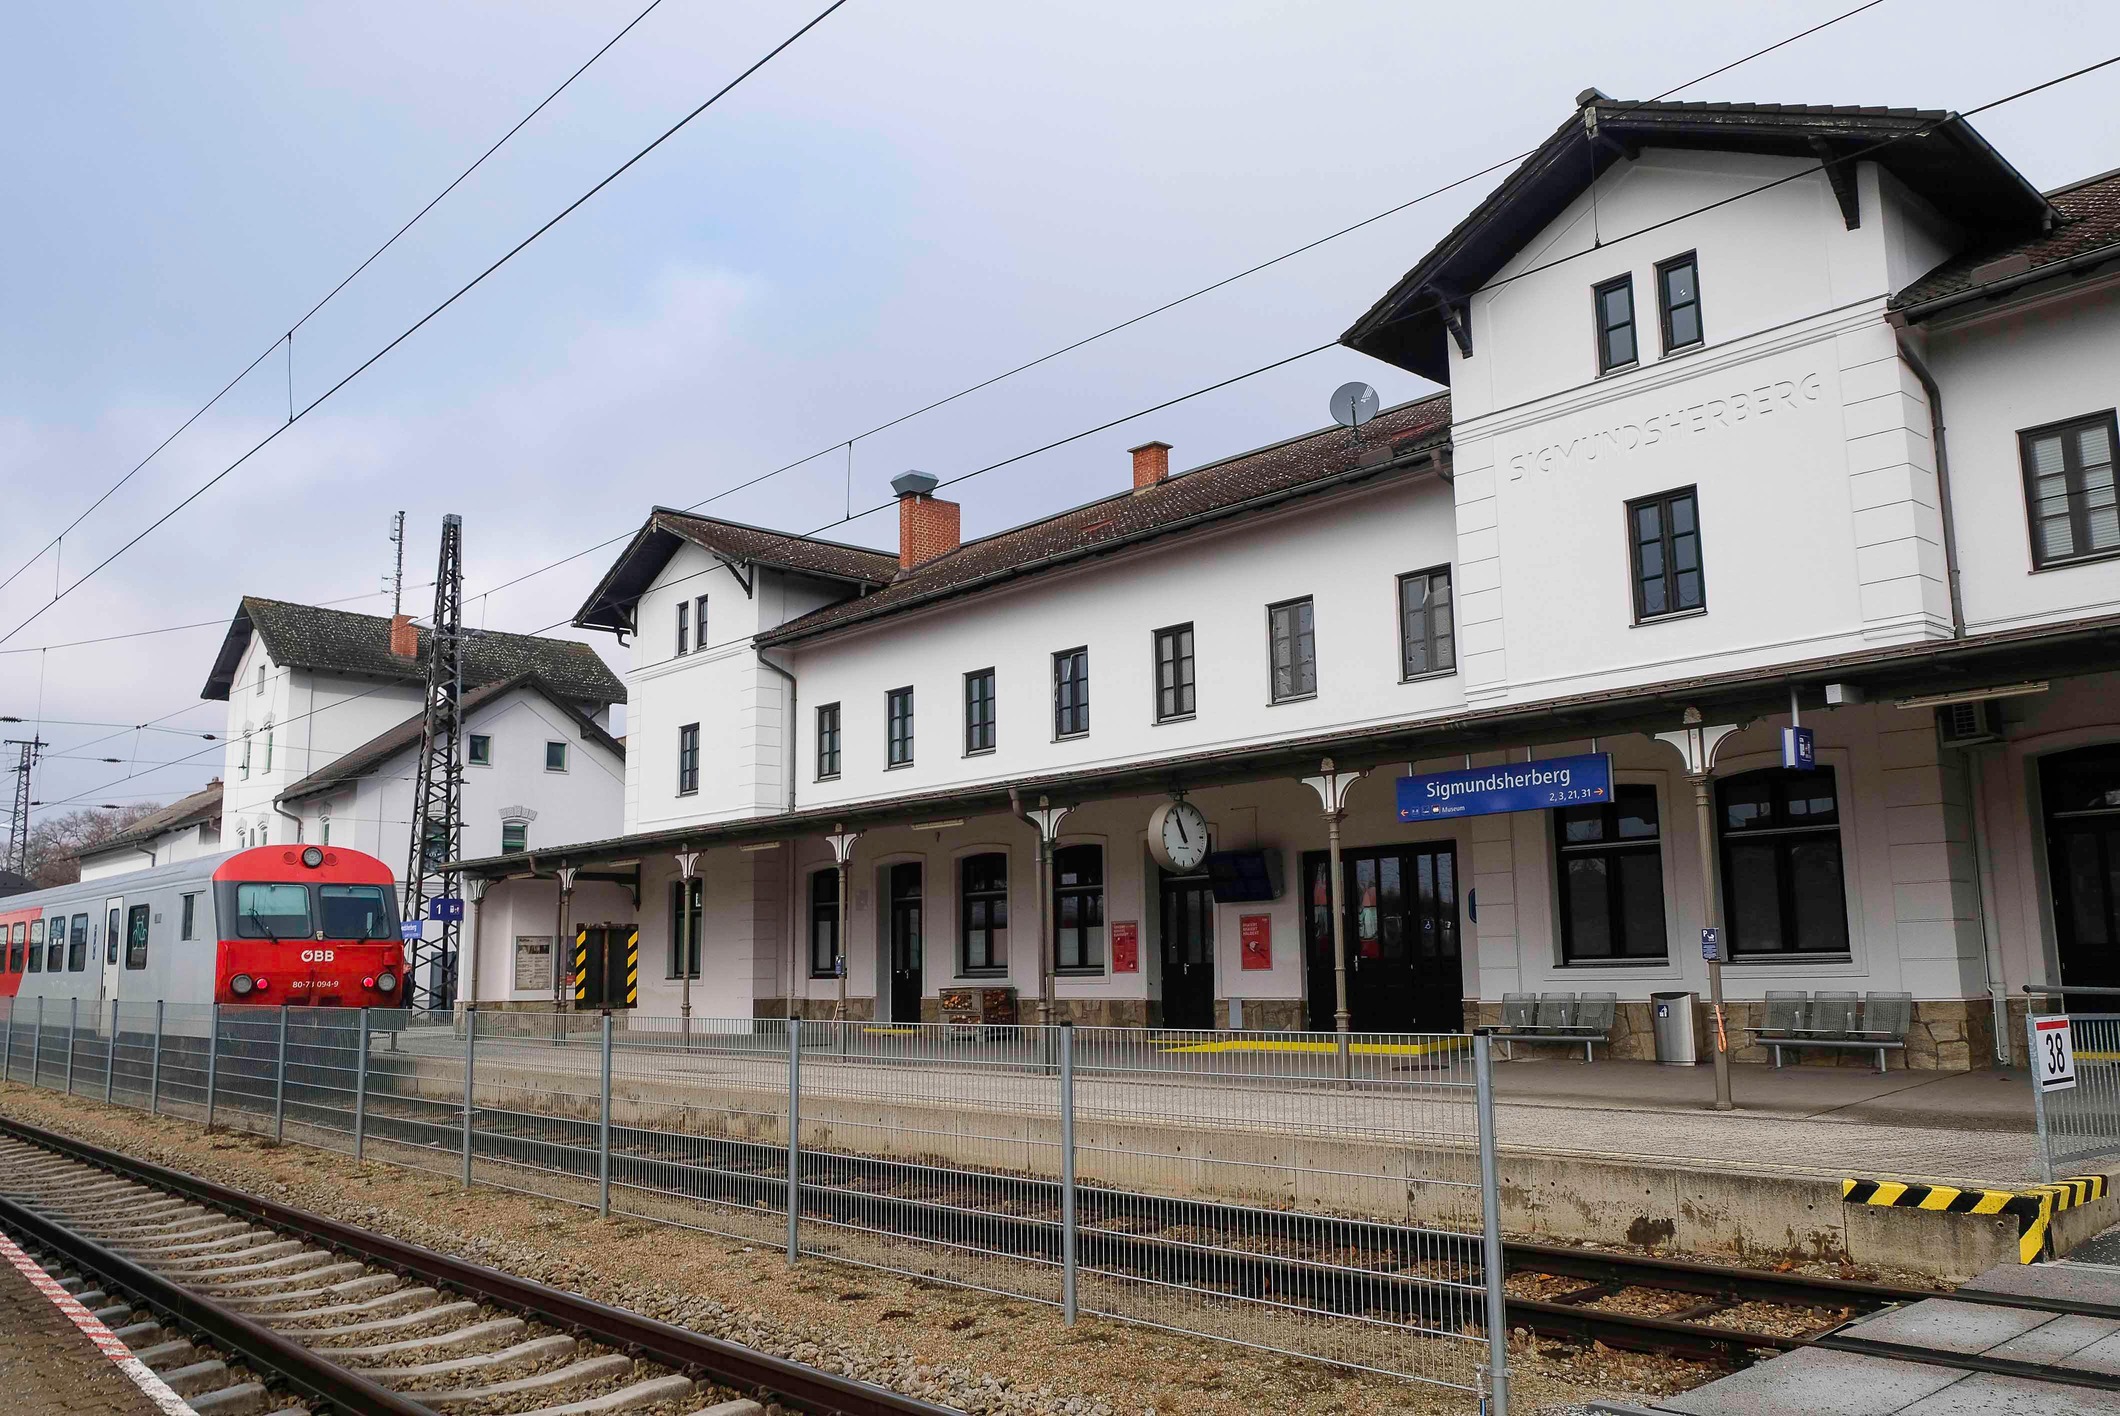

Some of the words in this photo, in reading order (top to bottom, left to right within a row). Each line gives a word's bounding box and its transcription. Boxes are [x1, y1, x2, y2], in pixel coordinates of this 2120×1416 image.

[1508, 371, 1820, 483] SIGMUNDSHERBERG
[1426, 768, 1571, 800] Sigmundsherberg
[1567, 789, 1580, 800] 21,
[1581, 788, 1591, 798] 31
[1441, 805, 1466, 813] Museum
[436, 904, 442, 915] 1
[316, 980, 339, 988] 094-9
[2045, 1032, 2066, 1075] 38
